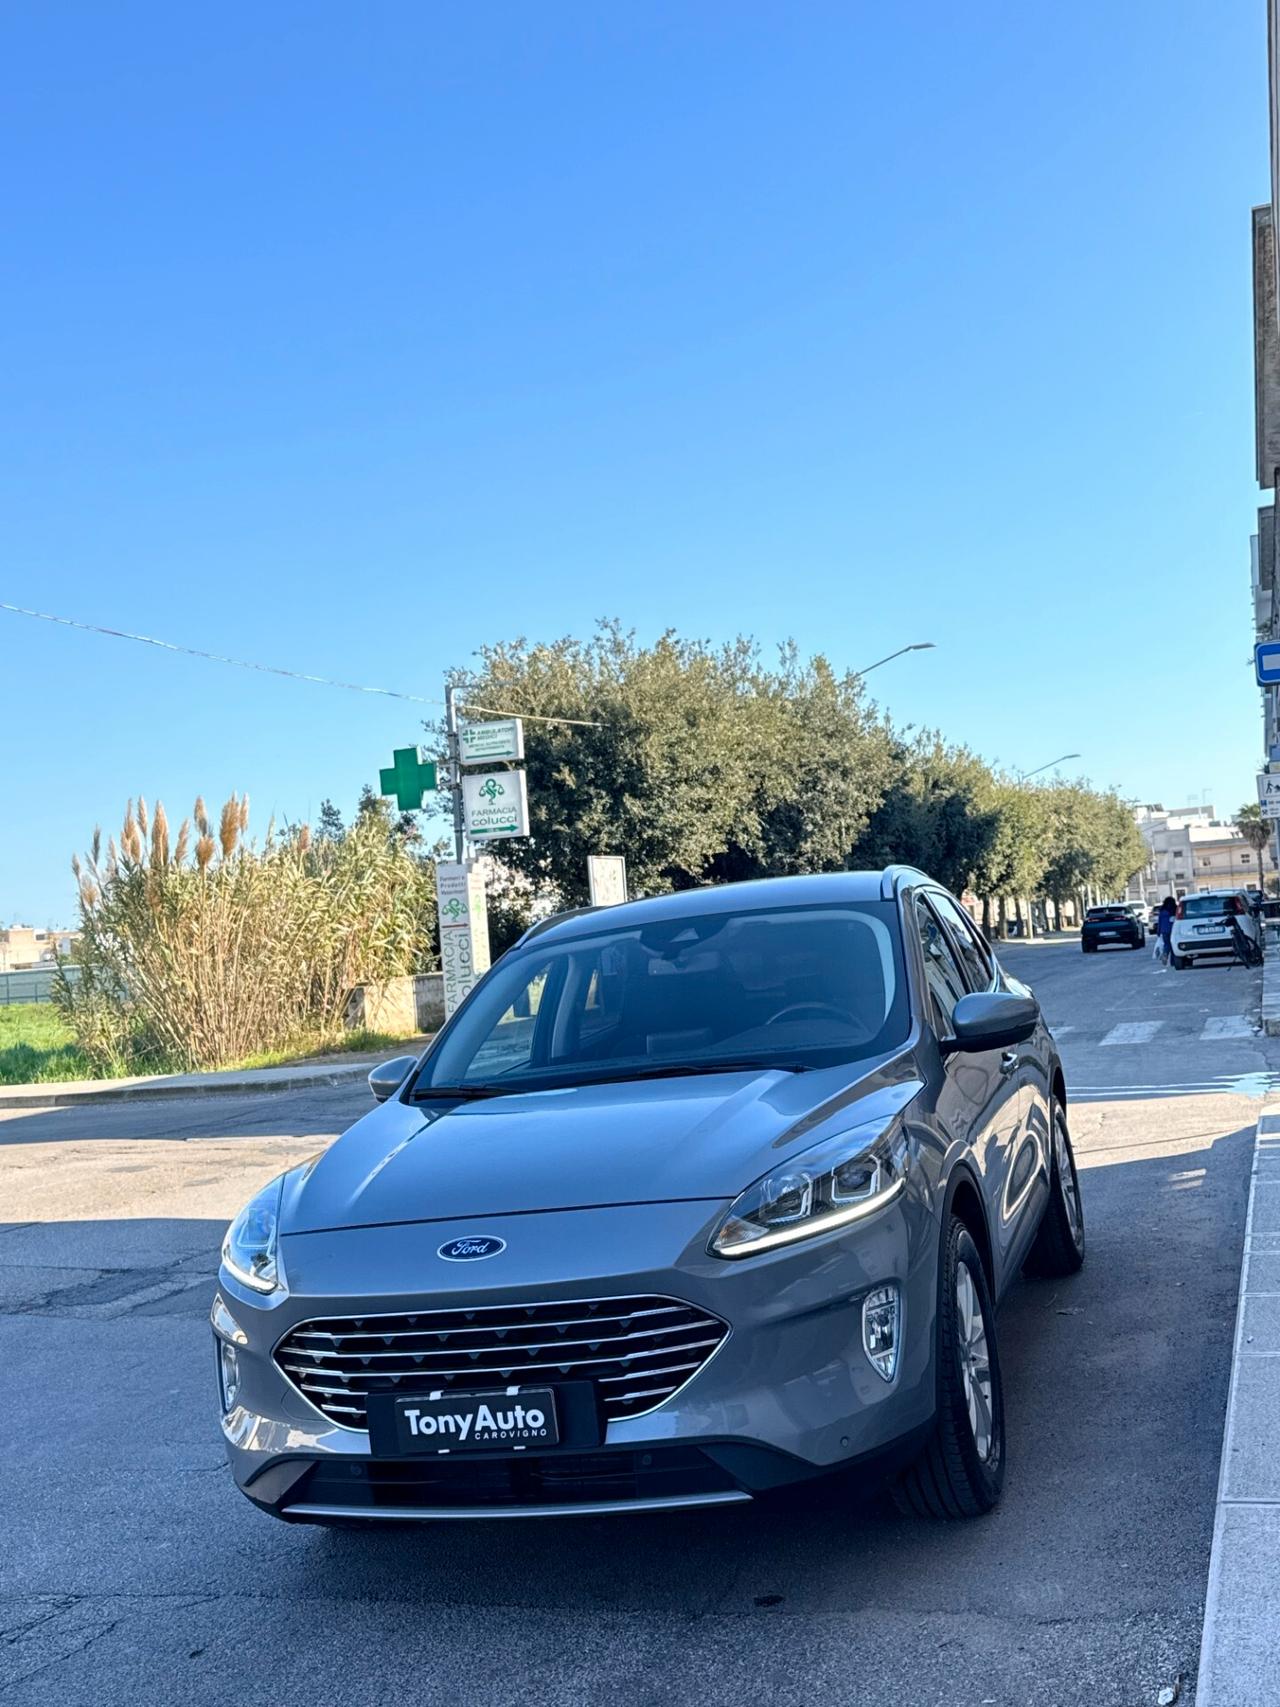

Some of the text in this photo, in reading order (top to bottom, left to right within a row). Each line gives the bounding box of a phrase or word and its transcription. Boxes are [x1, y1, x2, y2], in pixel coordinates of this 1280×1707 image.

[472, 806, 517, 817] FARMACIA
[472, 815, 517, 827] colucci
[443, 931, 458, 1012] FARMACIA
[455, 933, 472, 998] olucci
[451, 1239, 490, 1255] Ford
[404, 1404, 545, 1441] TonyAuto
[474, 1428, 547, 1440] CAROVIGNO
